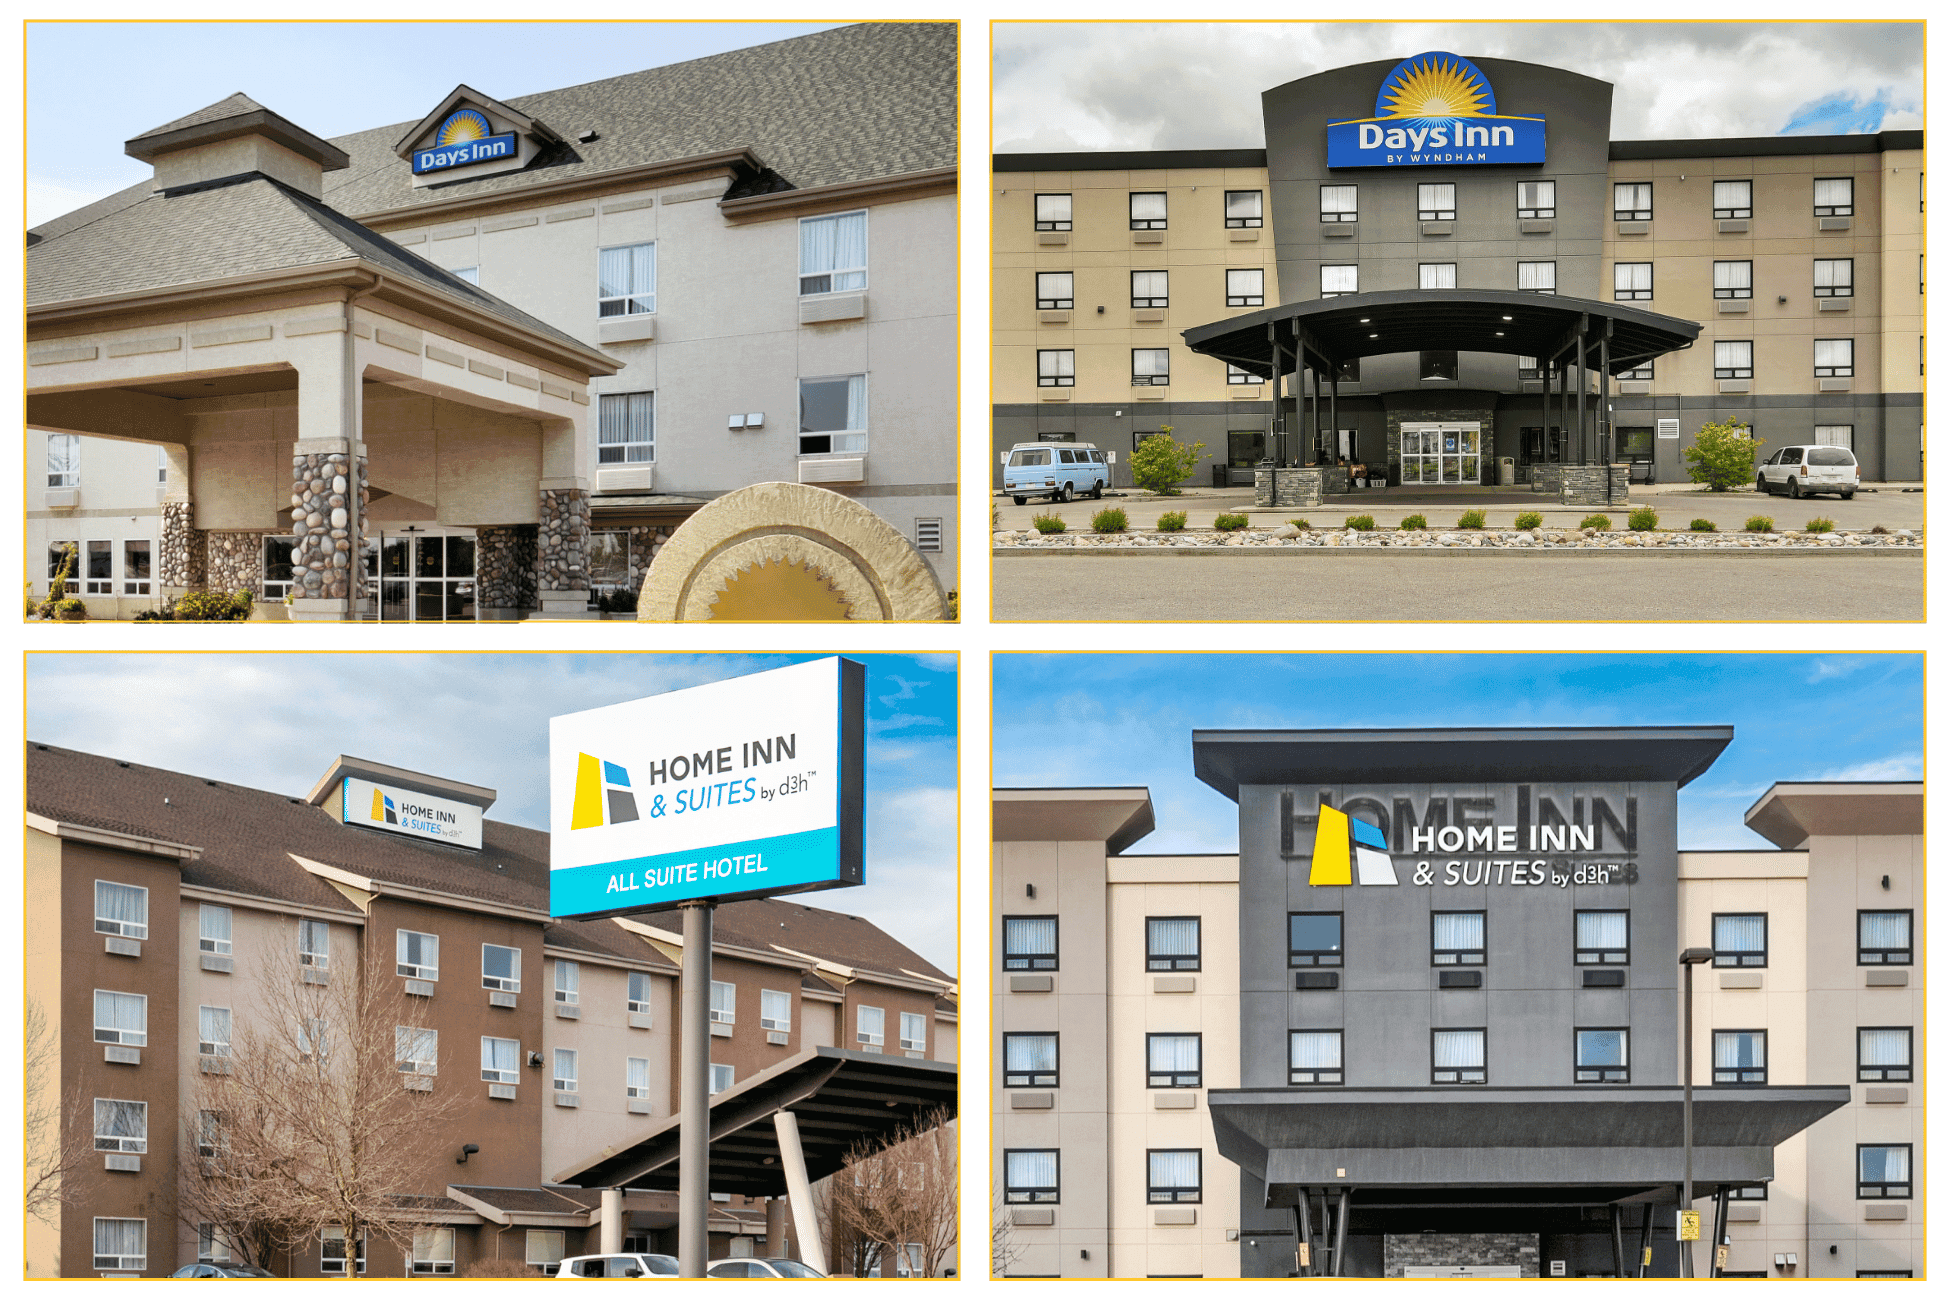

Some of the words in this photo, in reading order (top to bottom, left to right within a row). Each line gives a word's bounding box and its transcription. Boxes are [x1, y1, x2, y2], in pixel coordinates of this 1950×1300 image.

[1359, 123, 1448, 152] Days
[1455, 121, 1514, 147] Inn
[421, 148, 469, 169] Days
[472, 141, 506, 159] Inn
[1387, 154, 1403, 163] BY
[1410, 153, 1486, 163] WYNDHAM
[650, 745, 733, 786] HOME
[743, 733, 796, 769] INN
[650, 794, 667, 818] &
[674, 777, 757, 814] SUITES
[761, 786, 776, 801] by
[401, 817, 408, 827] &
[411, 819, 442, 834] SUITES
[402, 803, 433, 819] HOME
[436, 811, 456, 824] INN
[1412, 825, 1518, 852] HOME
[1530, 824, 1595, 852] INN
[606, 872, 640, 893] ALL
[644, 863, 698, 888] SUITE
[703, 853, 768, 879] HOTEL
[1412, 860, 1435, 886] &
[1443, 860, 1547, 886] SUITES
[1551, 870, 1570, 888] by
